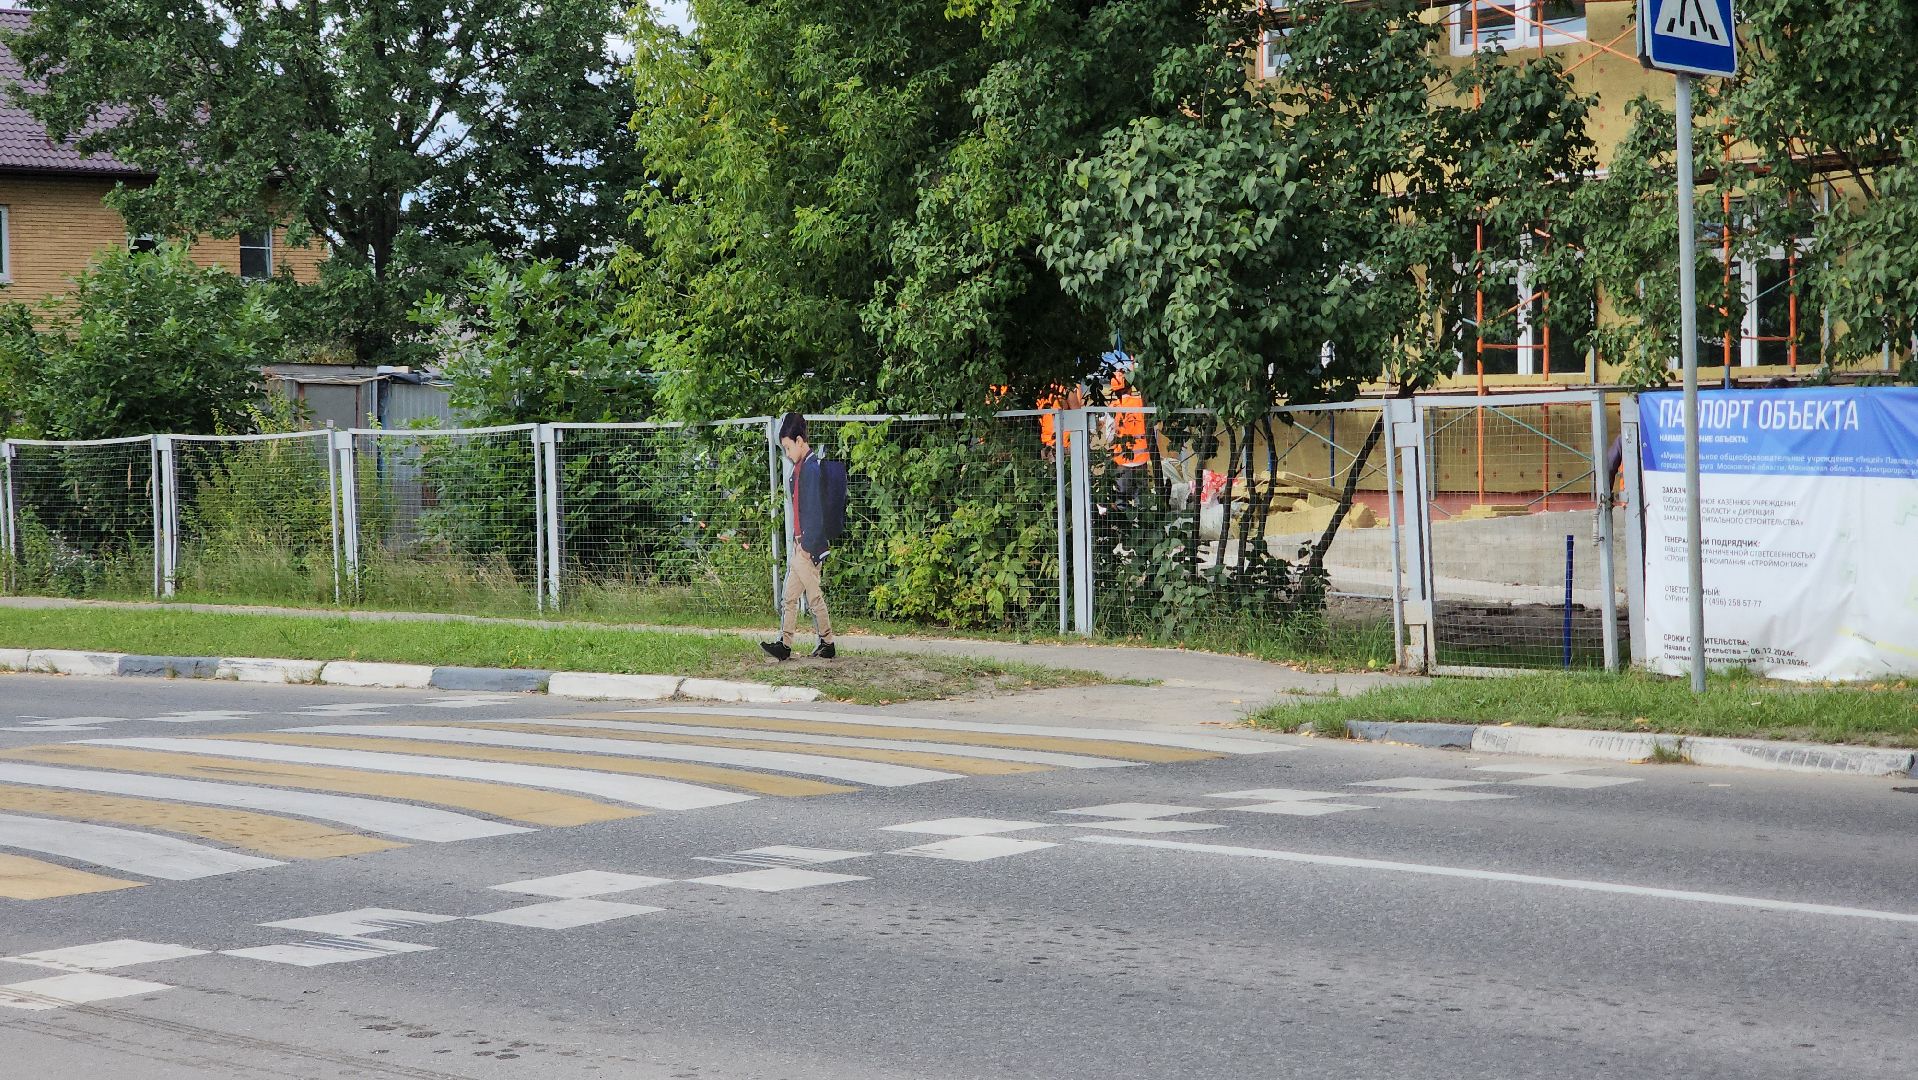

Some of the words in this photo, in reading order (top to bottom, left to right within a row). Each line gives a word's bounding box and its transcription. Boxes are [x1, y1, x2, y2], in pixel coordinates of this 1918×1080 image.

[1660, 399, 1753, 429] ПАПОРТ
[1758, 400, 1858, 430] ОБЪЕКТА
[1660, 434, 1713, 443] НАИМЕНИЕ
[1715, 435, 1748, 443] ОБЪЕКТА:
[1807, 456, 1853, 464] учреждение
[1662, 486, 1686, 494] ЗАКАЗЧ
[1711, 537, 1760, 548] ПОДРЯДЧИК:
[1701, 547, 1749, 557] ГРАНИЧЕННОЙ
[1663, 633, 1684, 642] СРОКИ
[1686, 636, 1749, 646] СИТЕЛЬСТВА:
[1664, 643, 1686, 651] Начало
[1664, 652, 1691, 661] Окончан
